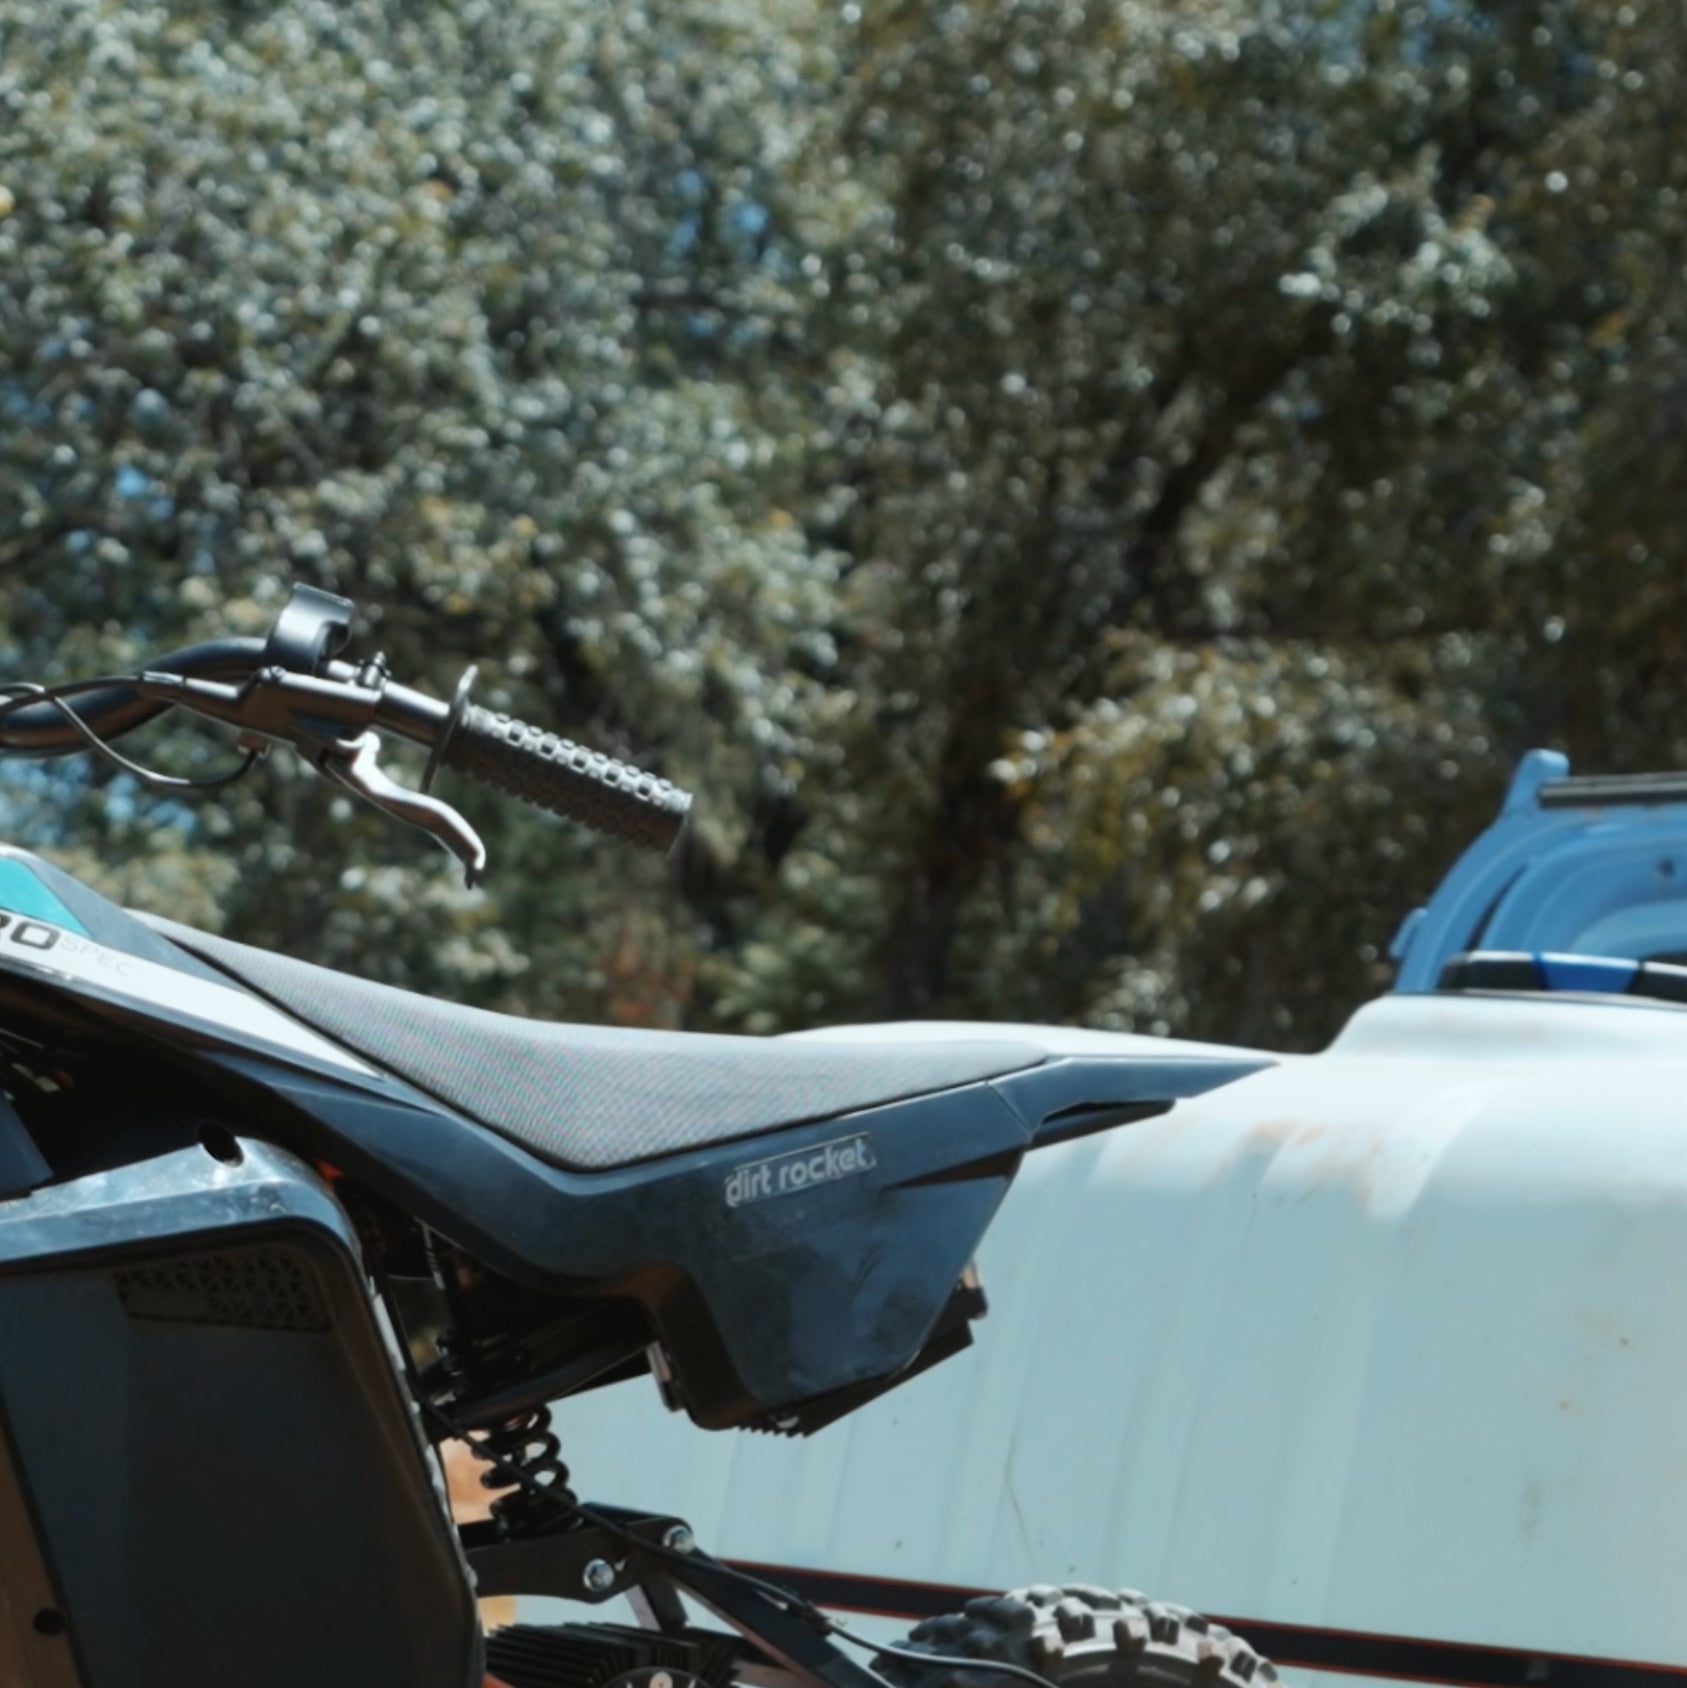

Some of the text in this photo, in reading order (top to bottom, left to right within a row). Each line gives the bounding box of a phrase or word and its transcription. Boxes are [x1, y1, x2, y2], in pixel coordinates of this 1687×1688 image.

[60, 934, 135, 978] SPEC
[725, 1138, 867, 1206] dirt rocket
